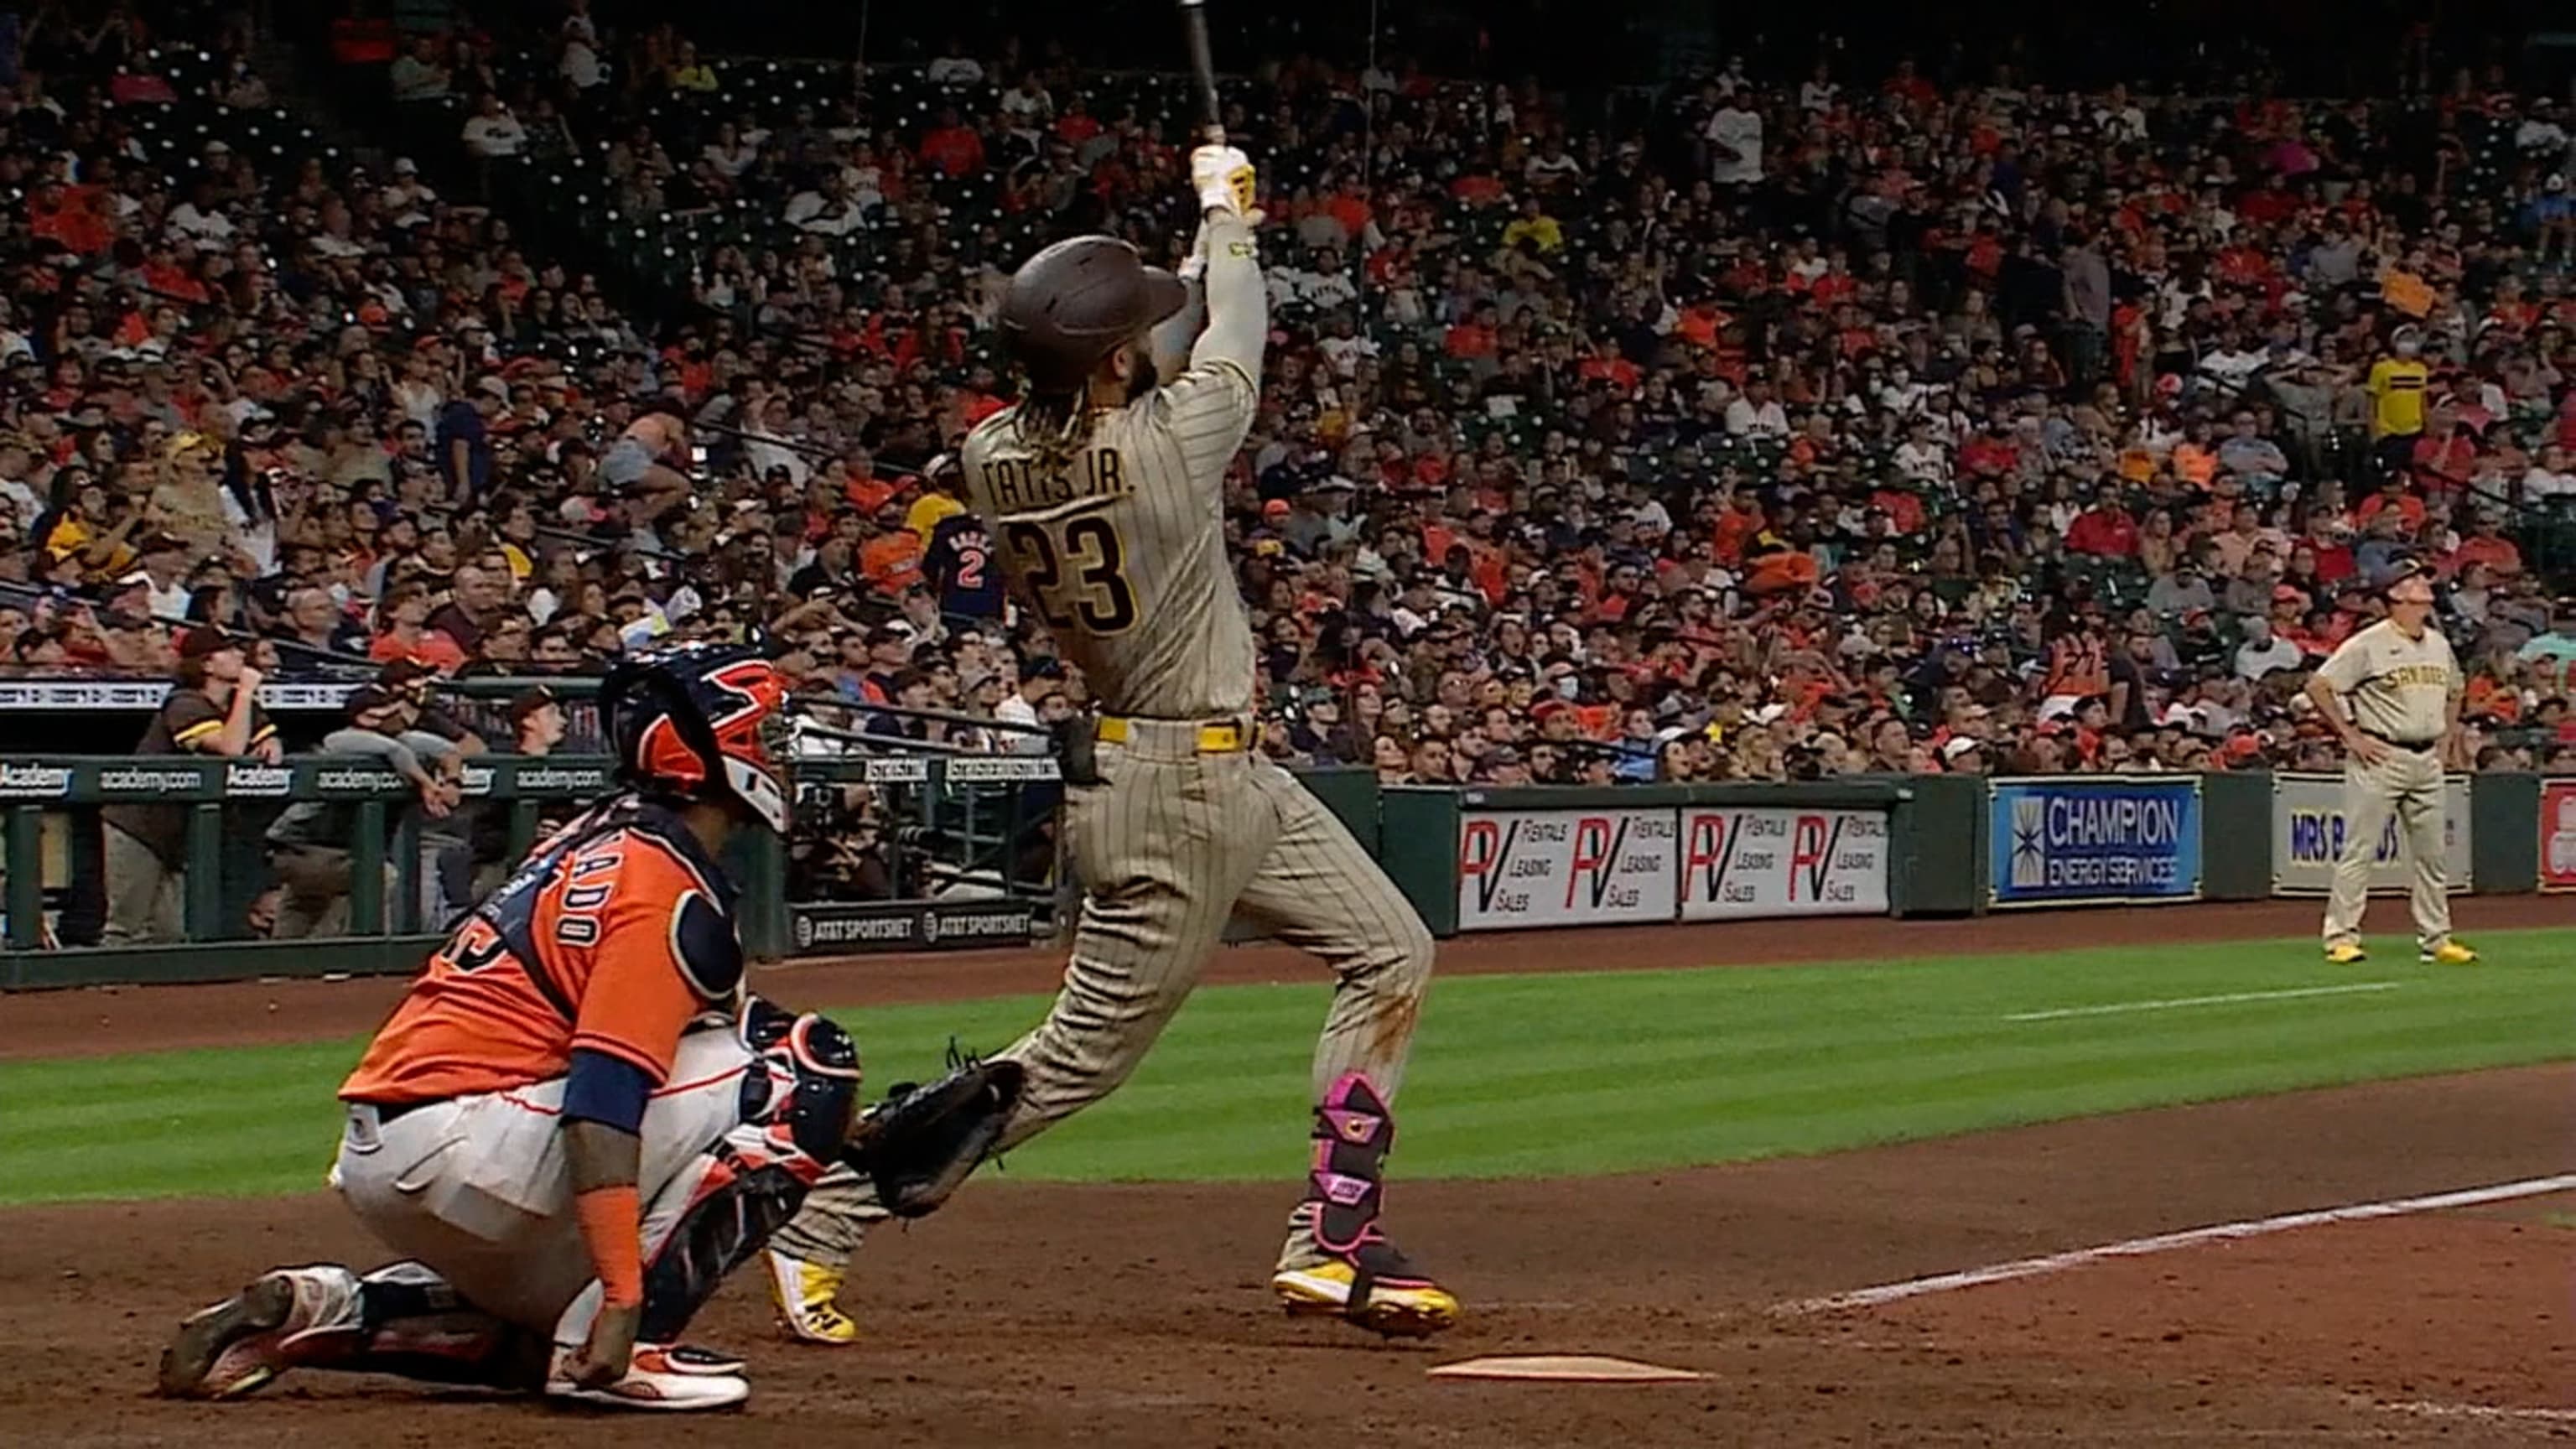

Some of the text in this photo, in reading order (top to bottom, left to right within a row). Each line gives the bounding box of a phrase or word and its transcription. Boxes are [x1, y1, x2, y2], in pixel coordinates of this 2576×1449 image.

[1084, 447, 1135, 496] JR.
[958, 549, 984, 589] 2
[1005, 515, 1137, 636] 23
[100, 767, 202, 792] academy.com
[227, 764, 294, 788] Academy
[517, 766, 604, 790] academy.com
[2049, 797, 2179, 846] CHAMPION
[2292, 813, 2328, 861] MRS
[1509, 854, 1552, 877] LEASING
[1620, 849, 1661, 874] LEASING
[1735, 848, 1774, 870] LEASING
[1836, 848, 1875, 870] LEASING
[2050, 856, 2179, 886] ENERGY SERVICES
[1496, 888, 1530, 911] SALES
[1607, 884, 1639, 908] SALES
[1724, 881, 1756, 902] SALES
[1826, 881, 1855, 901] SALES
[845, 918, 913, 939] SPORTSNET
[967, 913, 1030, 935] SPORTSNET
